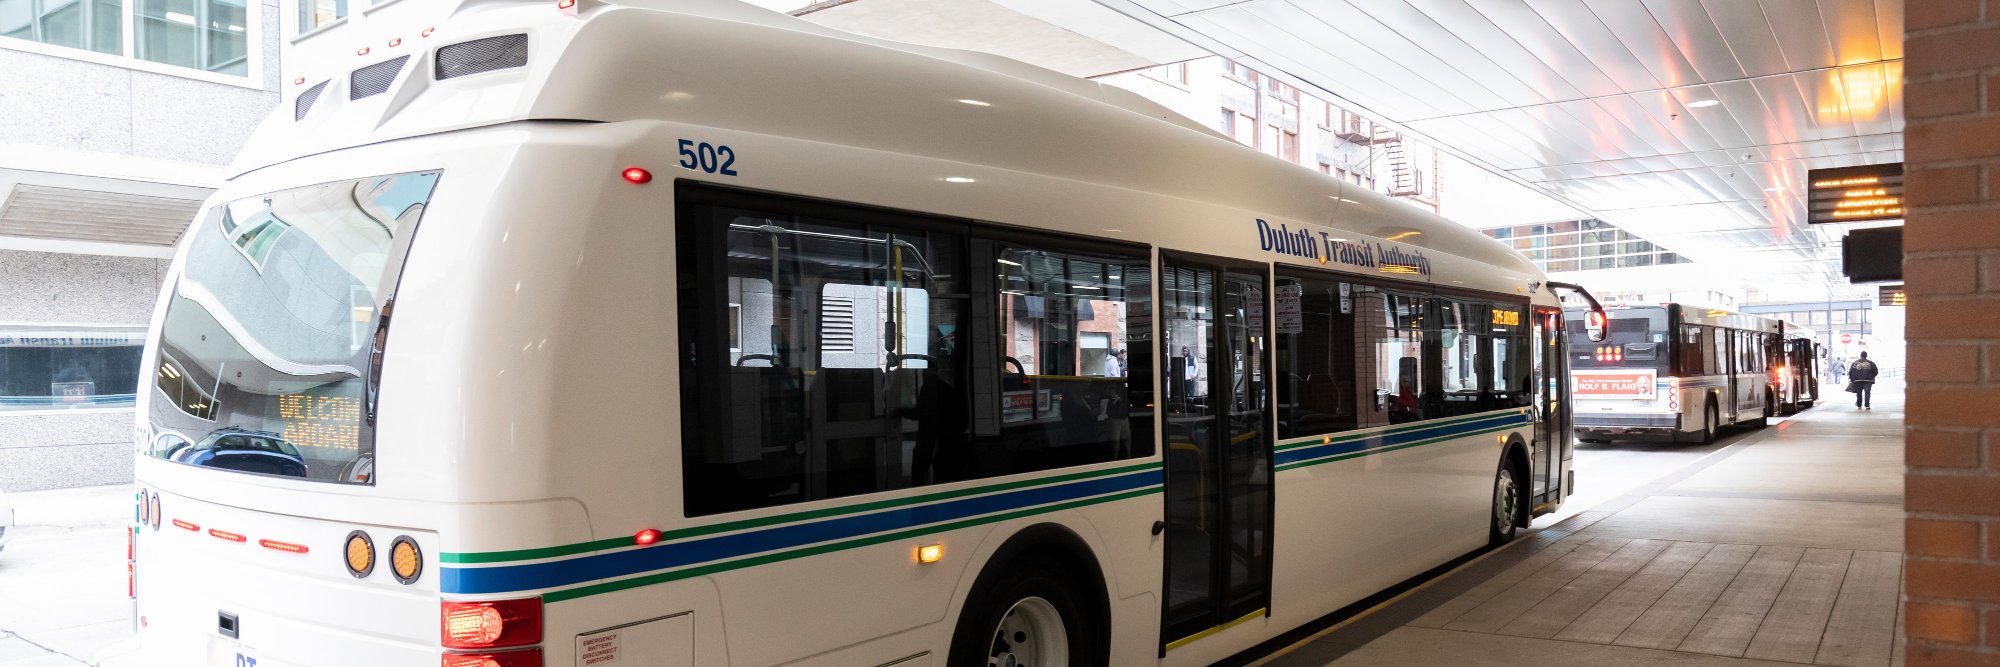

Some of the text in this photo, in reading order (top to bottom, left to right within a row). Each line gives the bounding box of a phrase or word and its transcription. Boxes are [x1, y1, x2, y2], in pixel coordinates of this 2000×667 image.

[678, 139, 737, 176] 502
[1256, 218, 1431, 281] Duluth Transit Authority
[583, 634, 617, 646] EMERGENCY
[588, 642, 612, 651] BATTERY
[582, 647, 617, 659] DISCONNECT
[586, 655, 614, 665] SWITCHES
